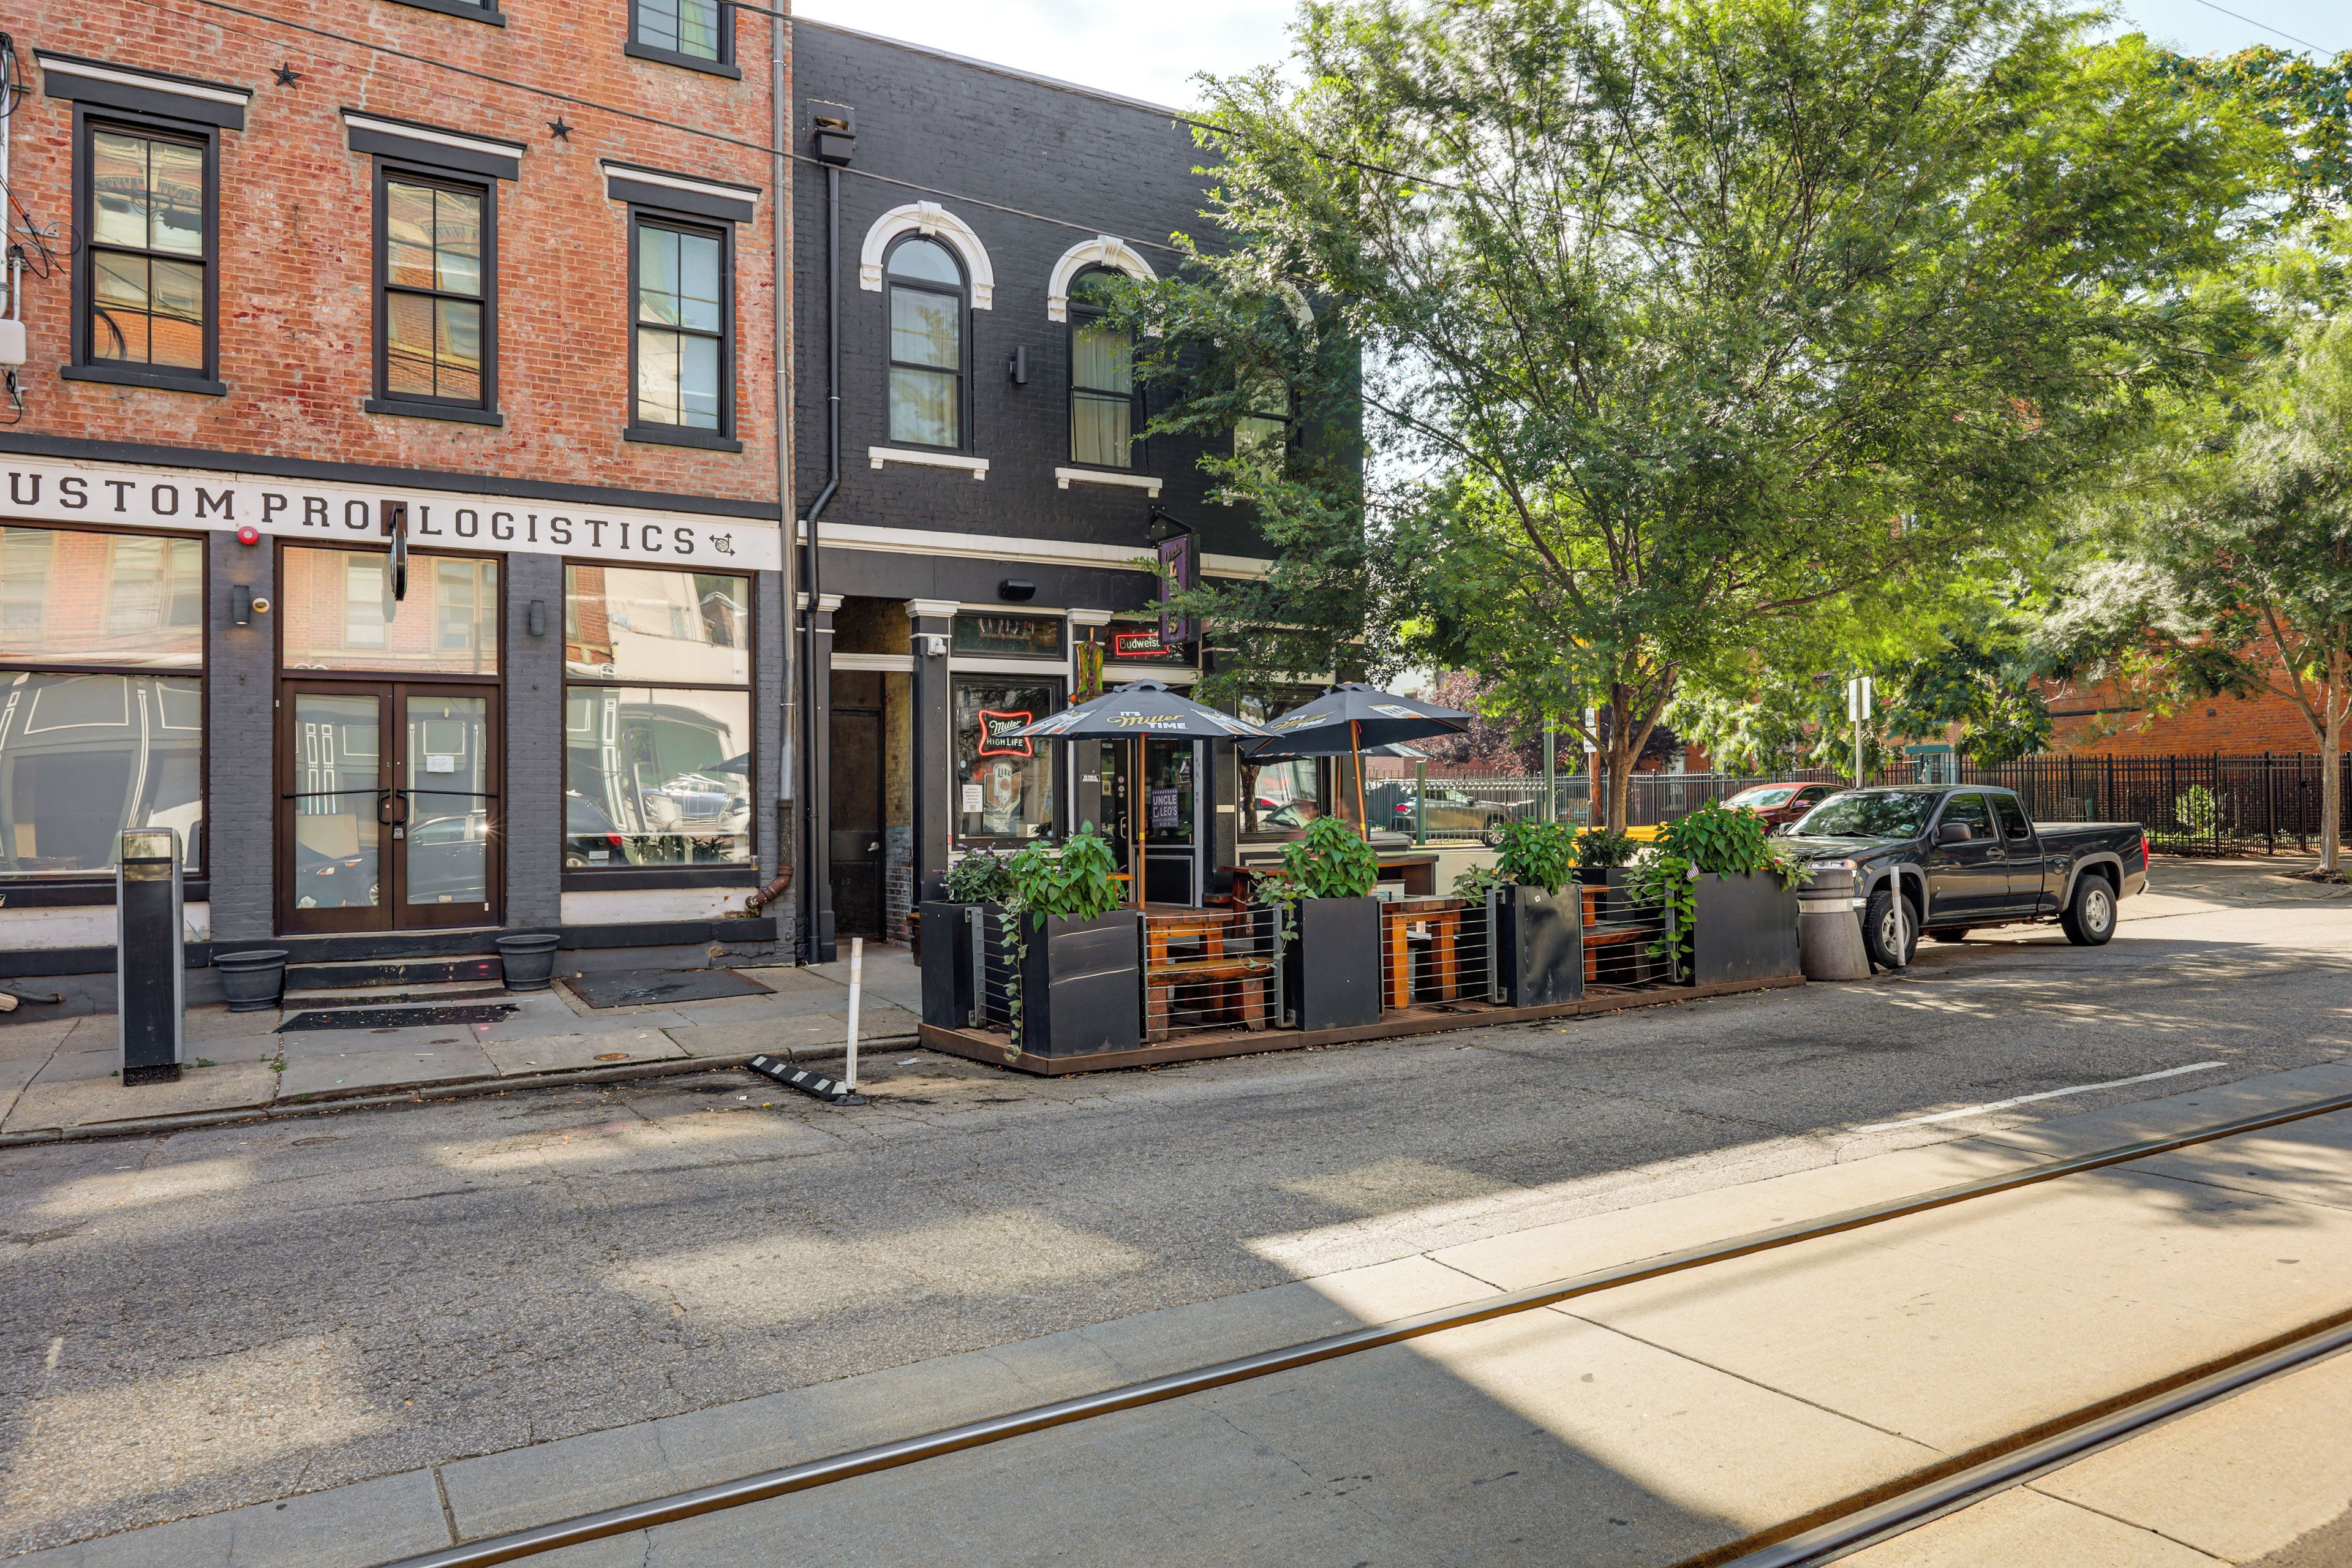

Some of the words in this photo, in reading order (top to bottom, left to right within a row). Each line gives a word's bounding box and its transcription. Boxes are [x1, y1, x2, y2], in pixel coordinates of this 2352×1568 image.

[261, 493, 369, 530] PRO
[420, 506, 695, 554] LOGISTICS
[1165, 544, 1183, 564] Uncle
[1119, 638, 1161, 649] Budweis
[1106, 714, 1186, 728] Miller
[989, 720, 1022, 734] Miller
[1006, 737, 1023, 747] LIFE
[998, 767, 1011, 777] Lite
[1153, 795, 1177, 805] UNCLE
[1160, 806, 1177, 816] LEO'S
